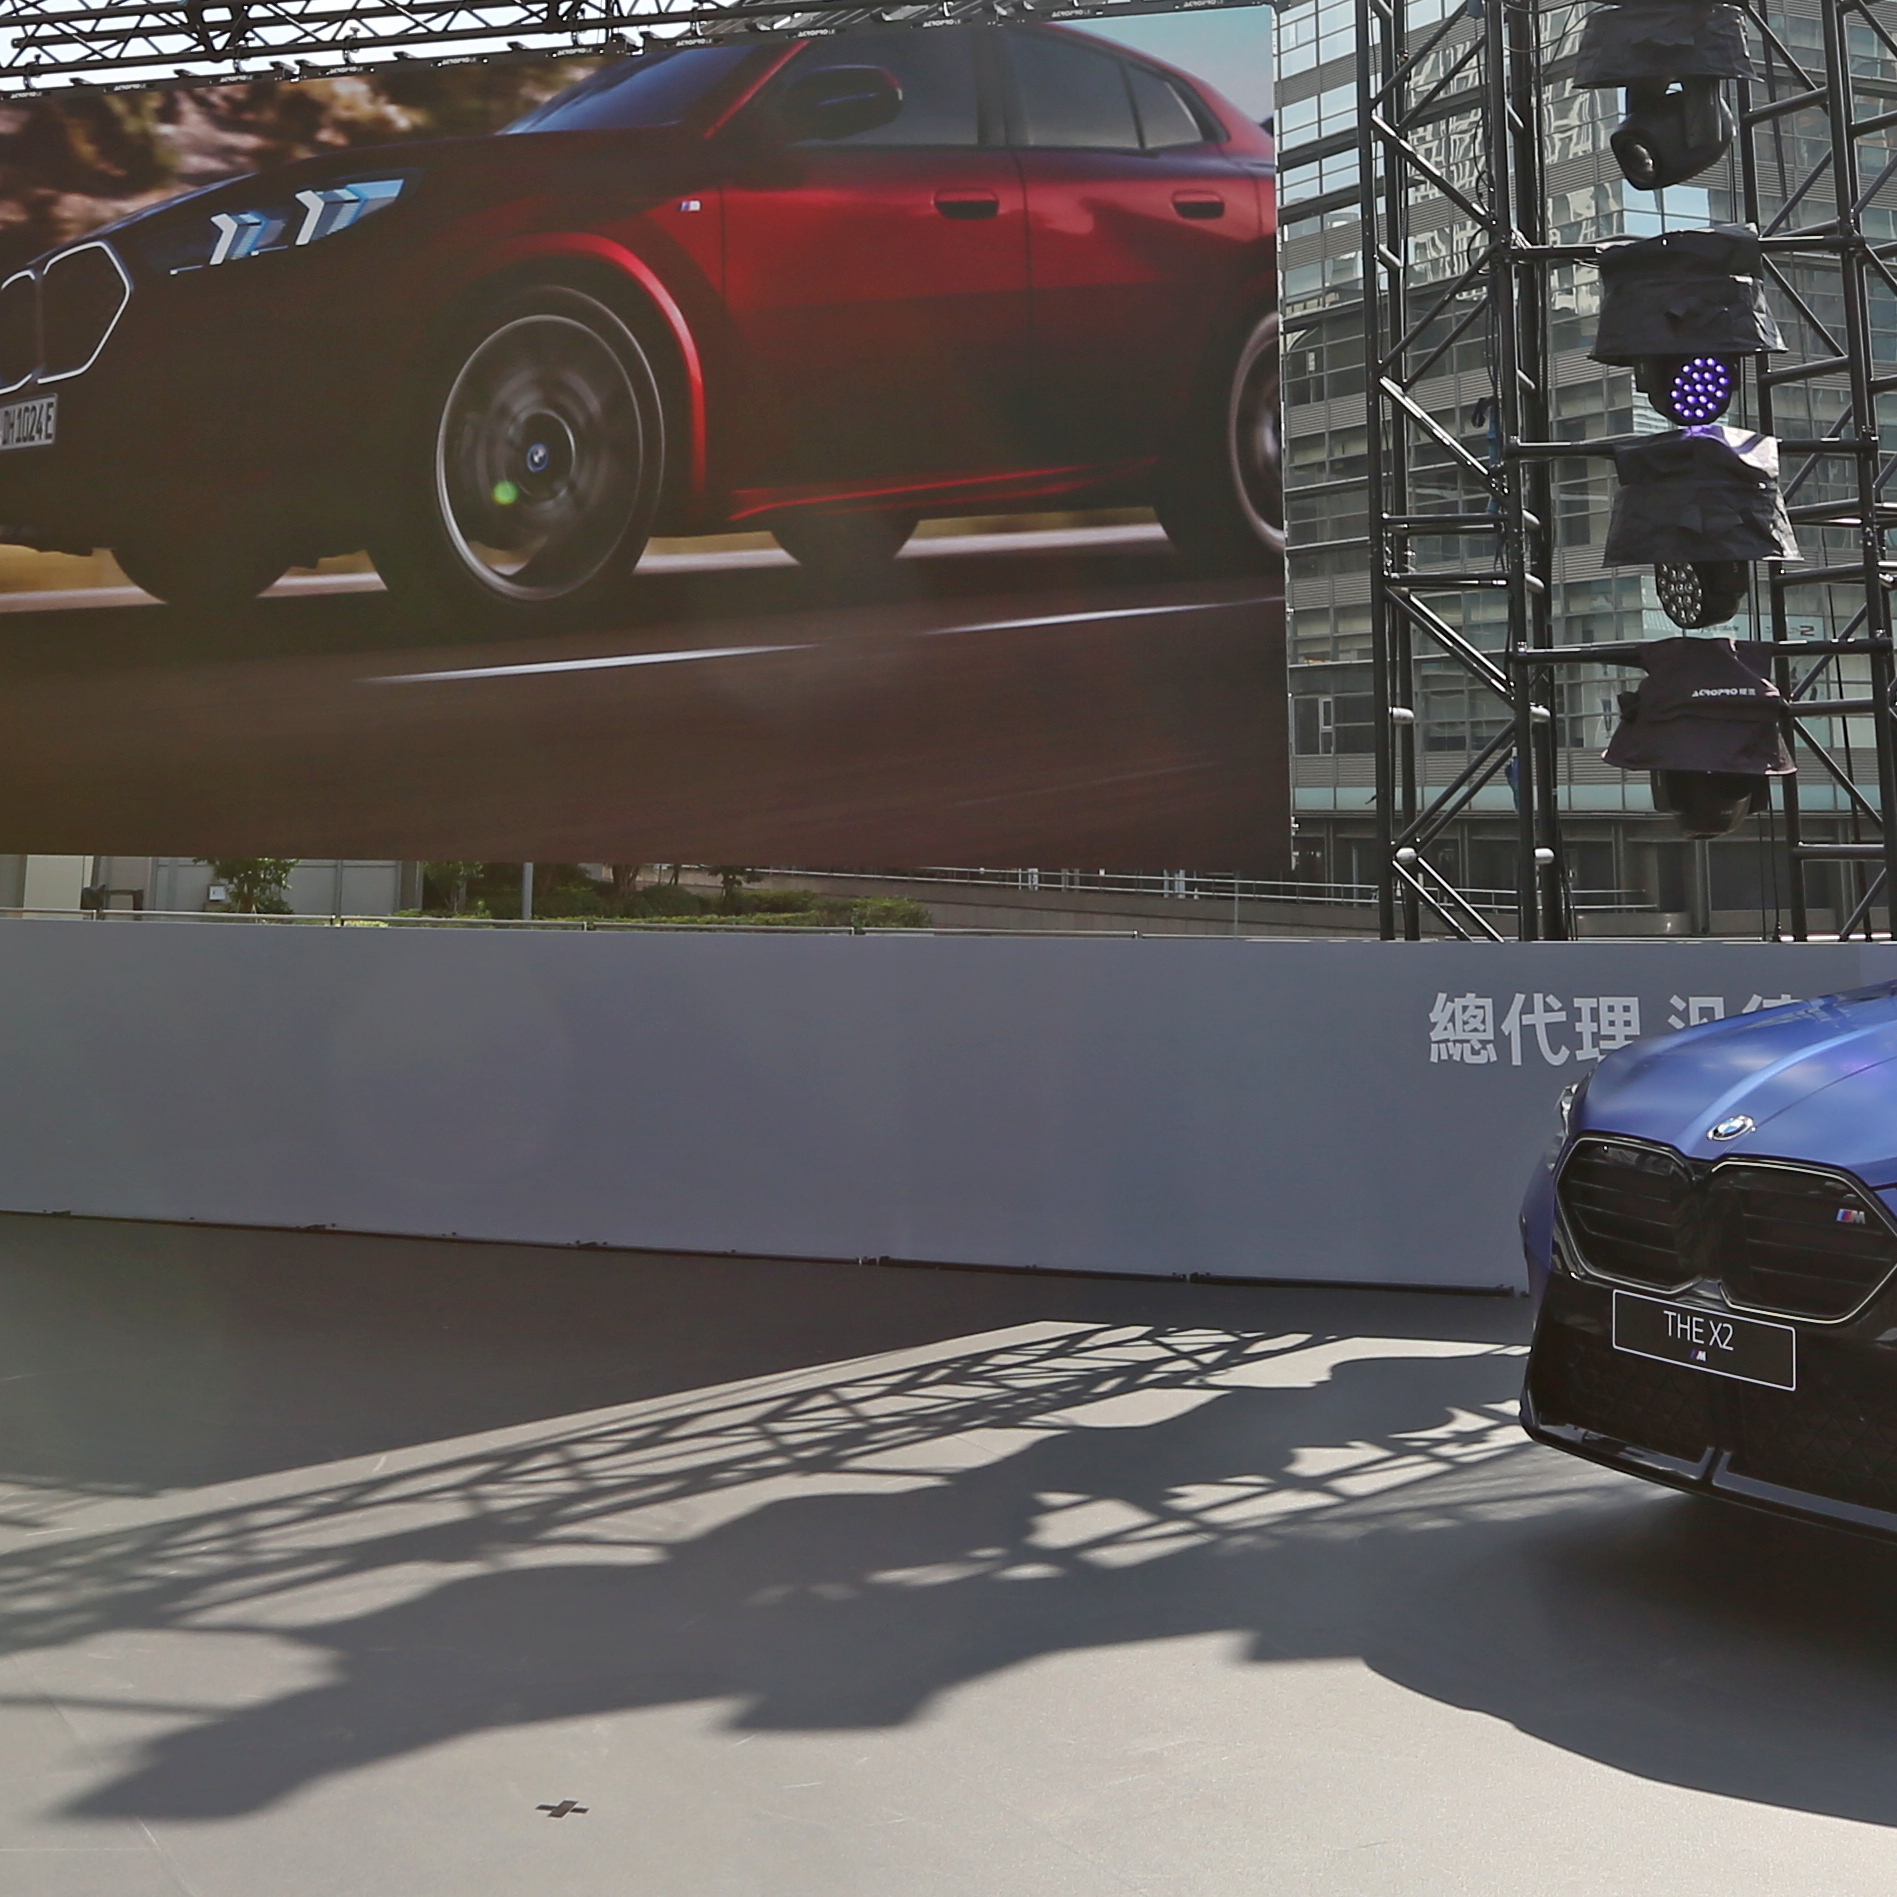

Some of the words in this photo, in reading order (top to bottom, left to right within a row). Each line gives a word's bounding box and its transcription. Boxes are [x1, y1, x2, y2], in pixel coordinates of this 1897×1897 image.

[1429, 992, 1643, 1066] 總代理
[1663, 1310, 1705, 1344] THE
[1709, 1319, 1734, 1351] X2
